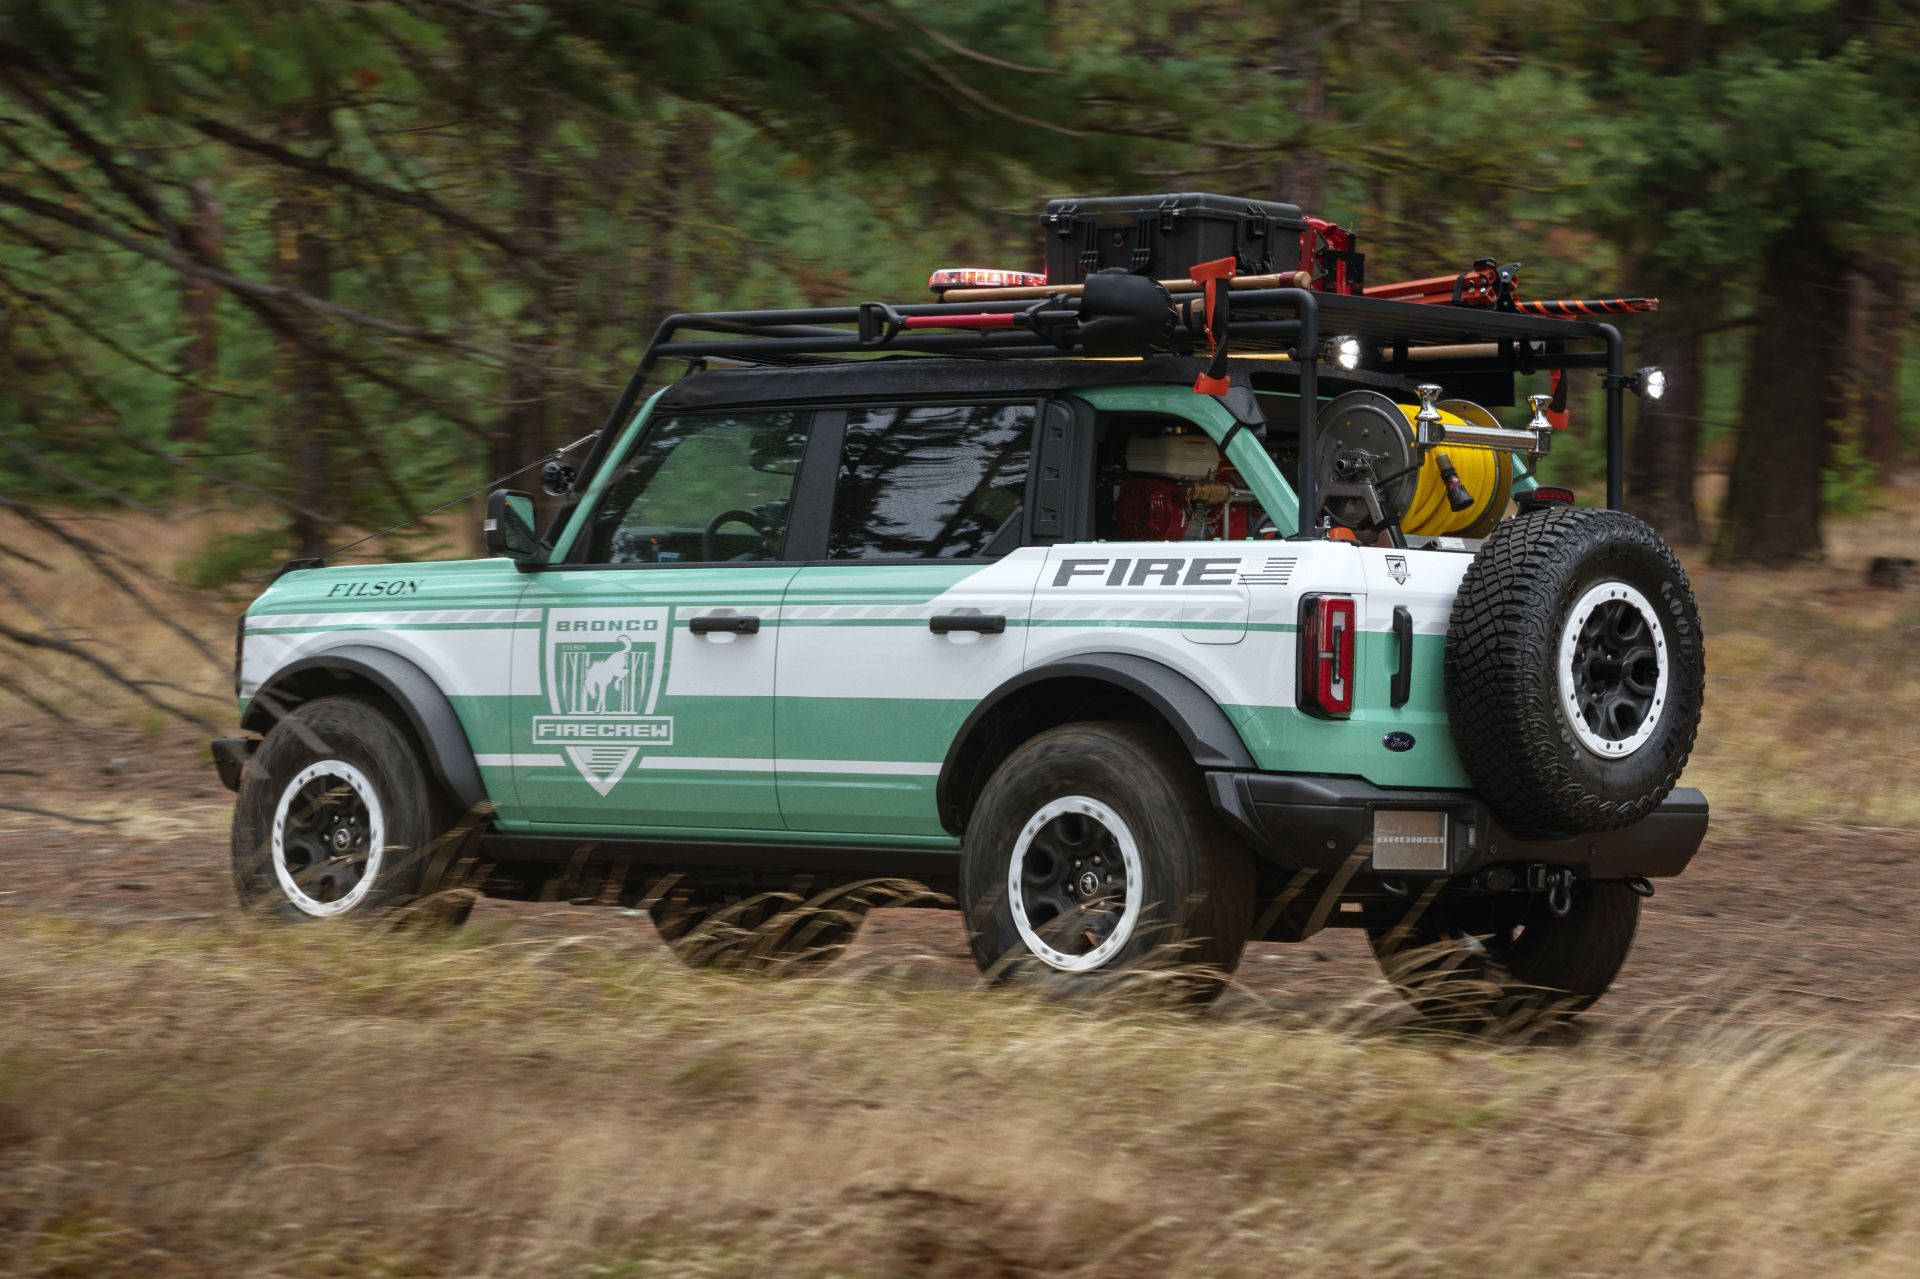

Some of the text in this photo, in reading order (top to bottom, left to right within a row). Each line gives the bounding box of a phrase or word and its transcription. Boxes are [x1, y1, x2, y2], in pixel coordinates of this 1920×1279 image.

[1052, 558, 1242, 586] FIRE
[327, 580, 424, 597] FILSON
[556, 620, 659, 632] BRONCO
[538, 723, 668, 737] FIRECREW
[1376, 836, 1444, 844] BRONCO
